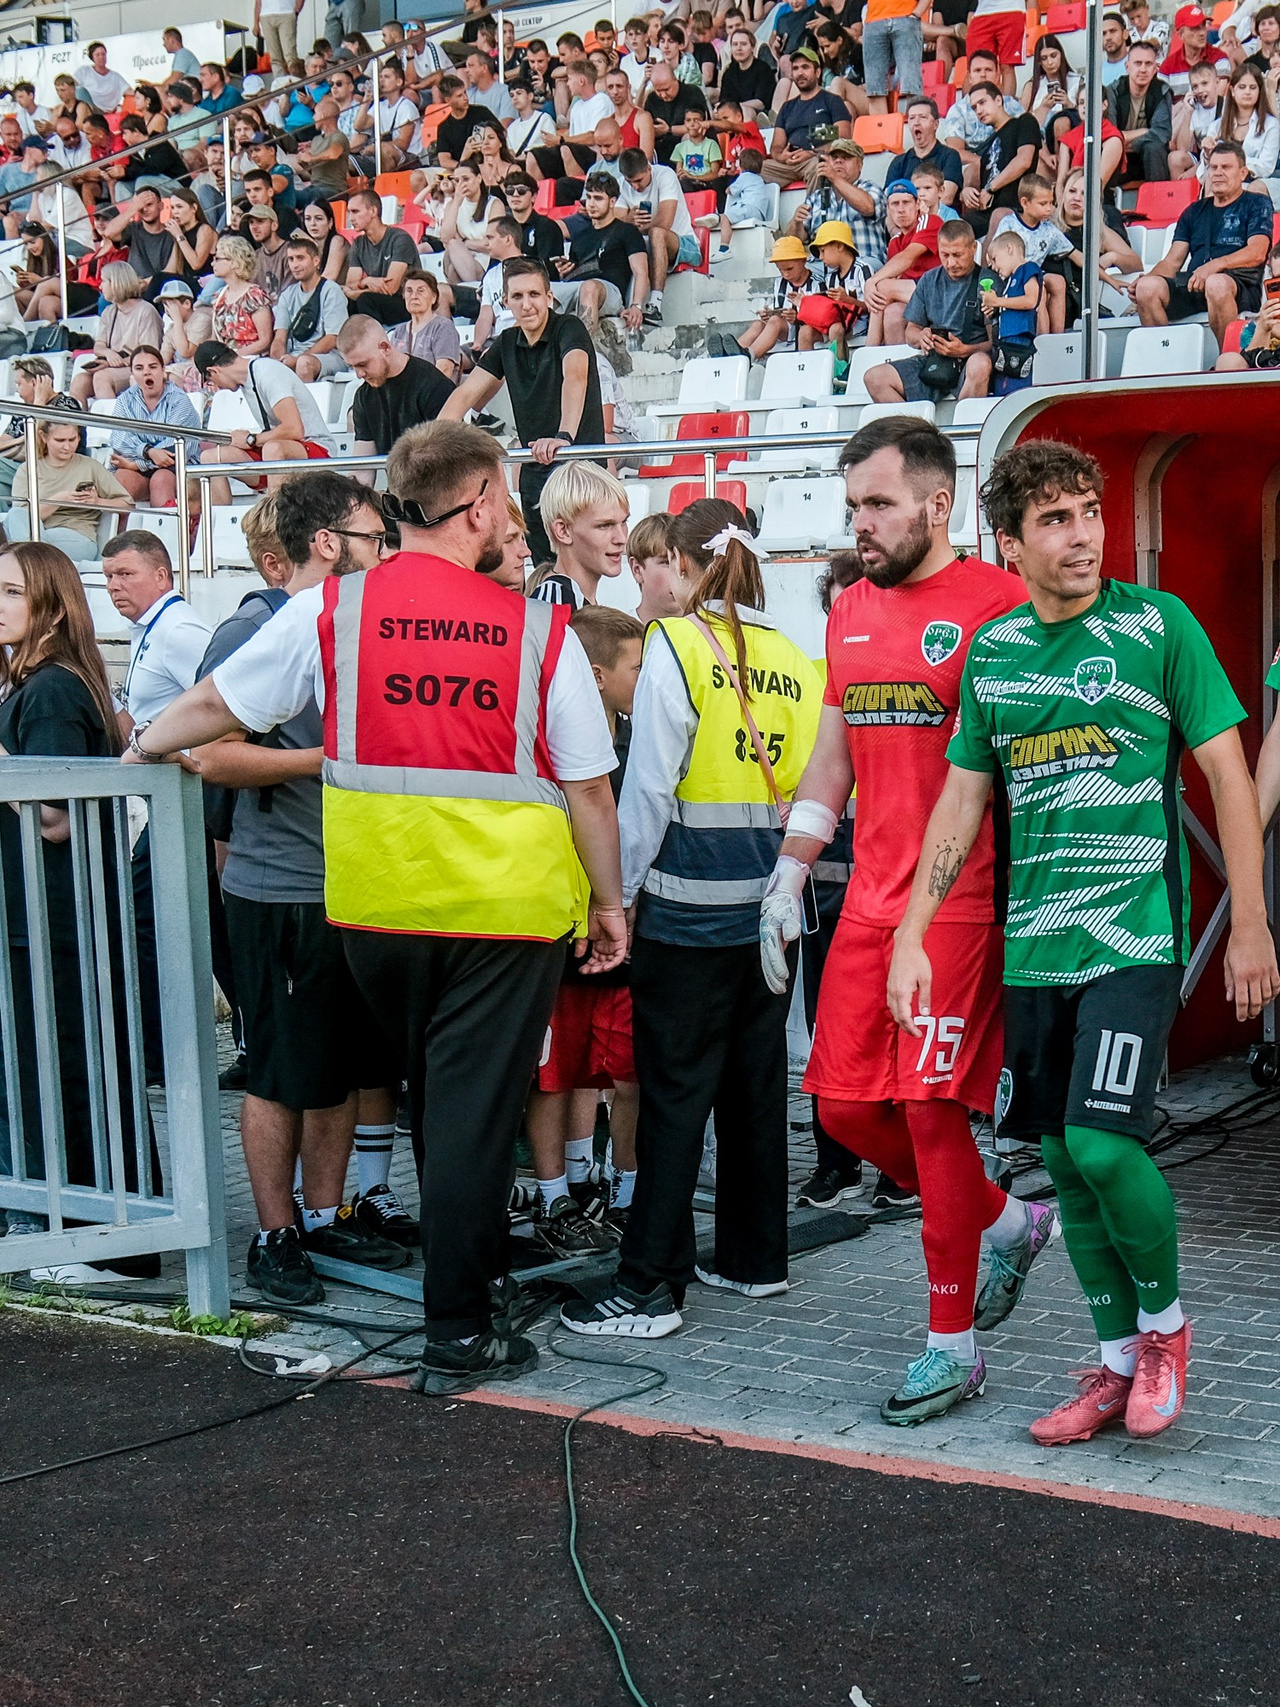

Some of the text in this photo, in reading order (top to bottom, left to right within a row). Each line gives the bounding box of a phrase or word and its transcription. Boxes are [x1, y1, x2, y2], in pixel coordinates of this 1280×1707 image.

[132, 54, 167, 71] Пресса
[379, 617, 508, 647] STEWARD
[384, 673, 499, 711] S076
[843, 684, 945, 712] СПОРИМ!
[843, 712, 946, 725] ВЗЛЕТИМ
[1010, 725, 1118, 767] СПОРИМ!
[1012, 754, 1119, 782] ВЗЛЕТИМ
[914, 1015, 965, 1072] 75
[1092, 1029, 1143, 1096] 10
[1088, 1293, 1112, 1306] AKO
